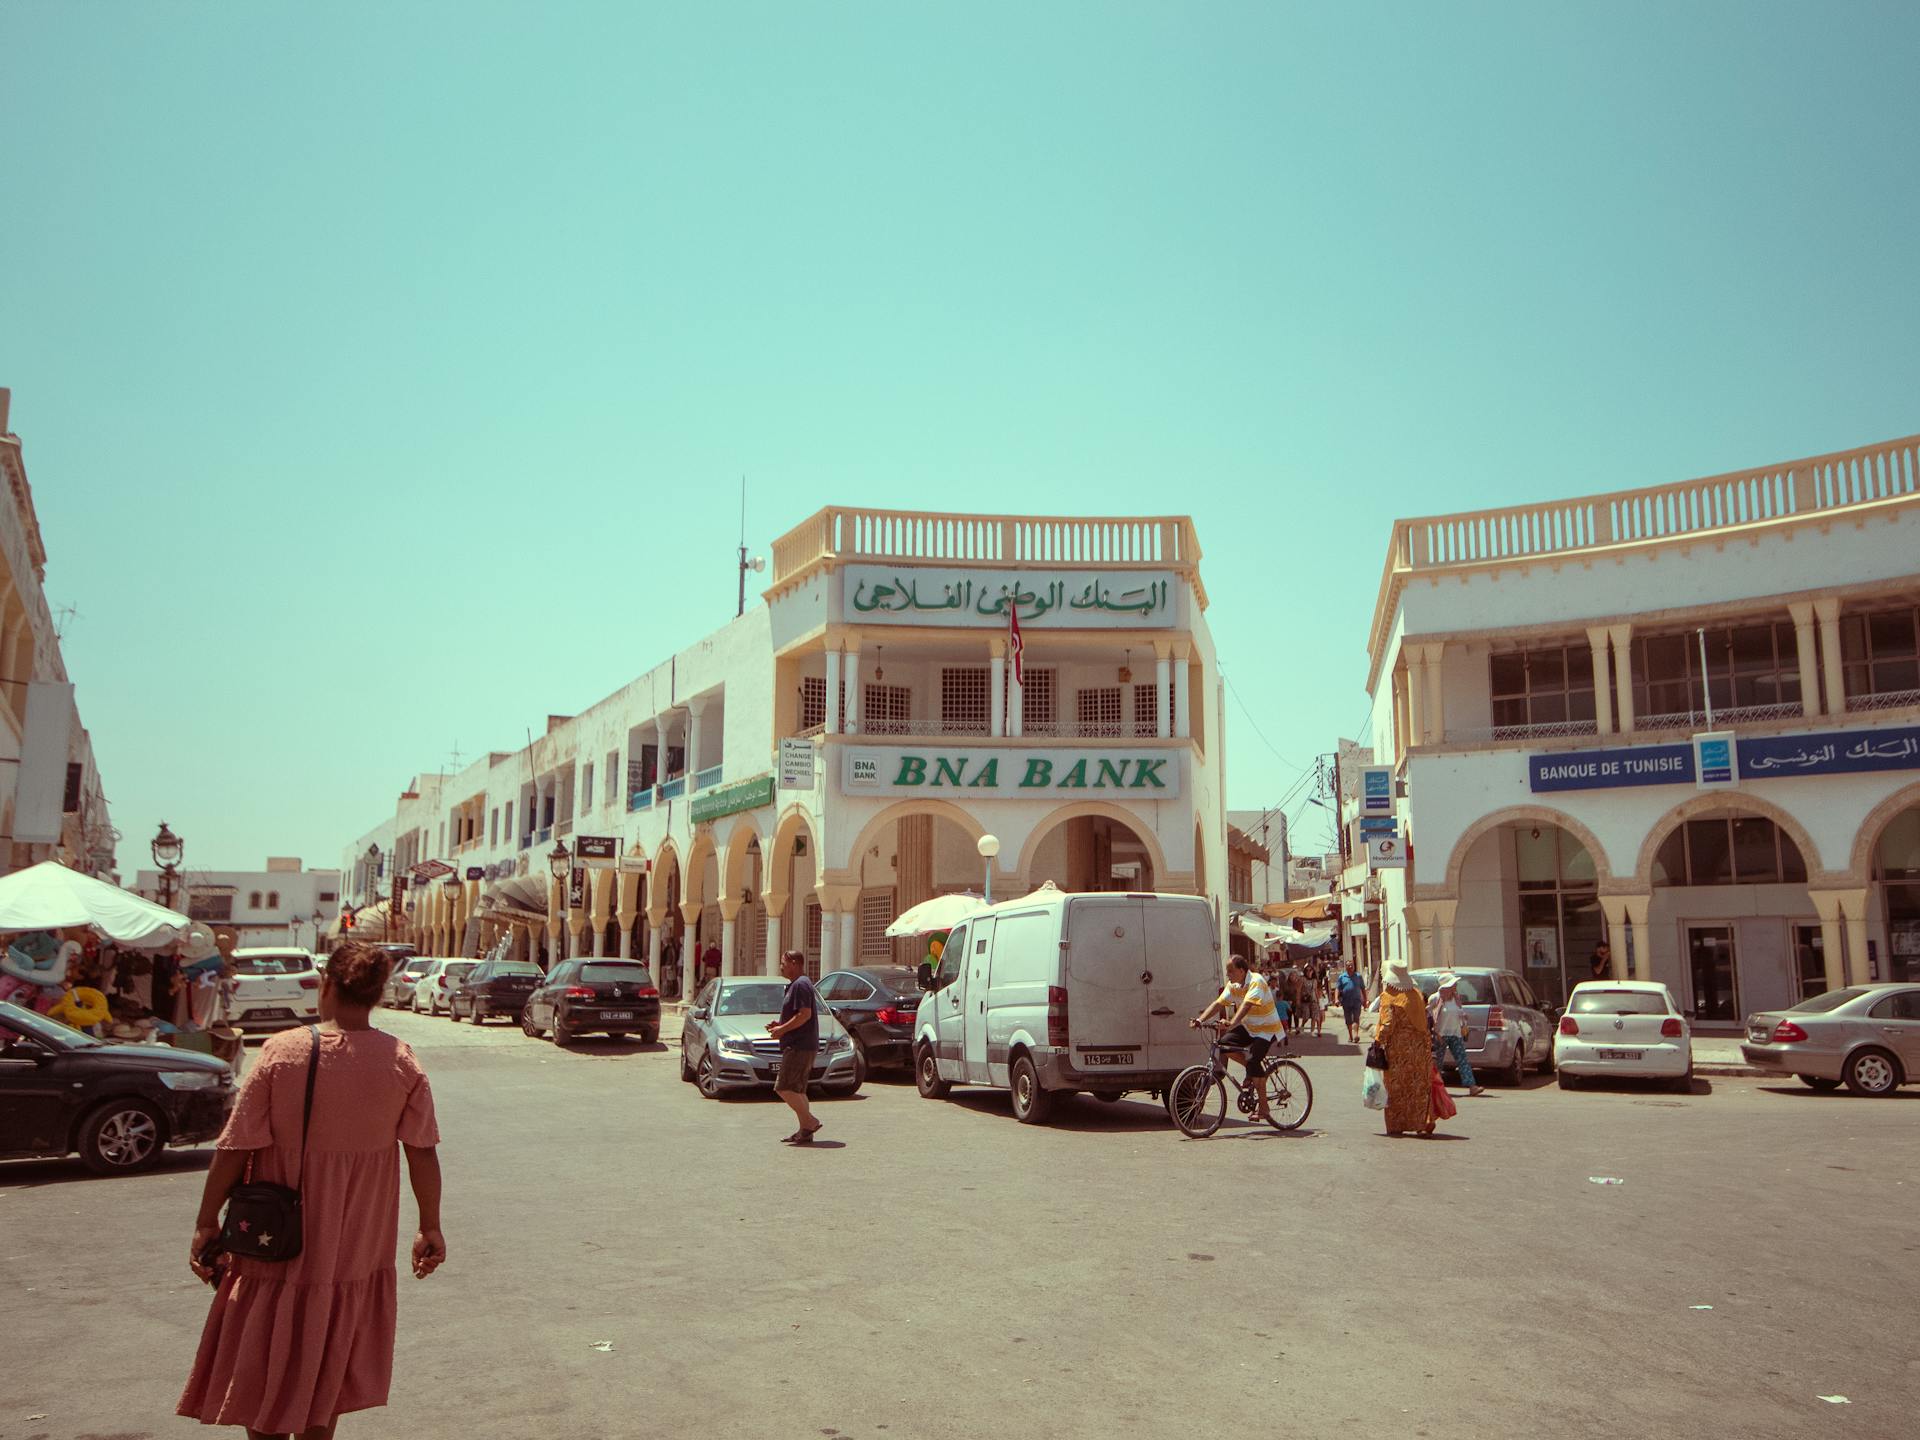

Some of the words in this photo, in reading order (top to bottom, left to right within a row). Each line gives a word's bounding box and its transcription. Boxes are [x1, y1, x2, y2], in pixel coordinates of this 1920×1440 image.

[854, 761, 876, 770] BNA
[893, 756, 999, 787] BNA
[1018, 758, 1167, 788] BANK
[1540, 763, 1597, 780] BANQUE
[1601, 761, 1620, 775] DE
[1623, 756, 1683, 774] TUNISIE
[1087, 1055, 1100, 1065] 143
[1118, 1054, 1132, 1064] 120
